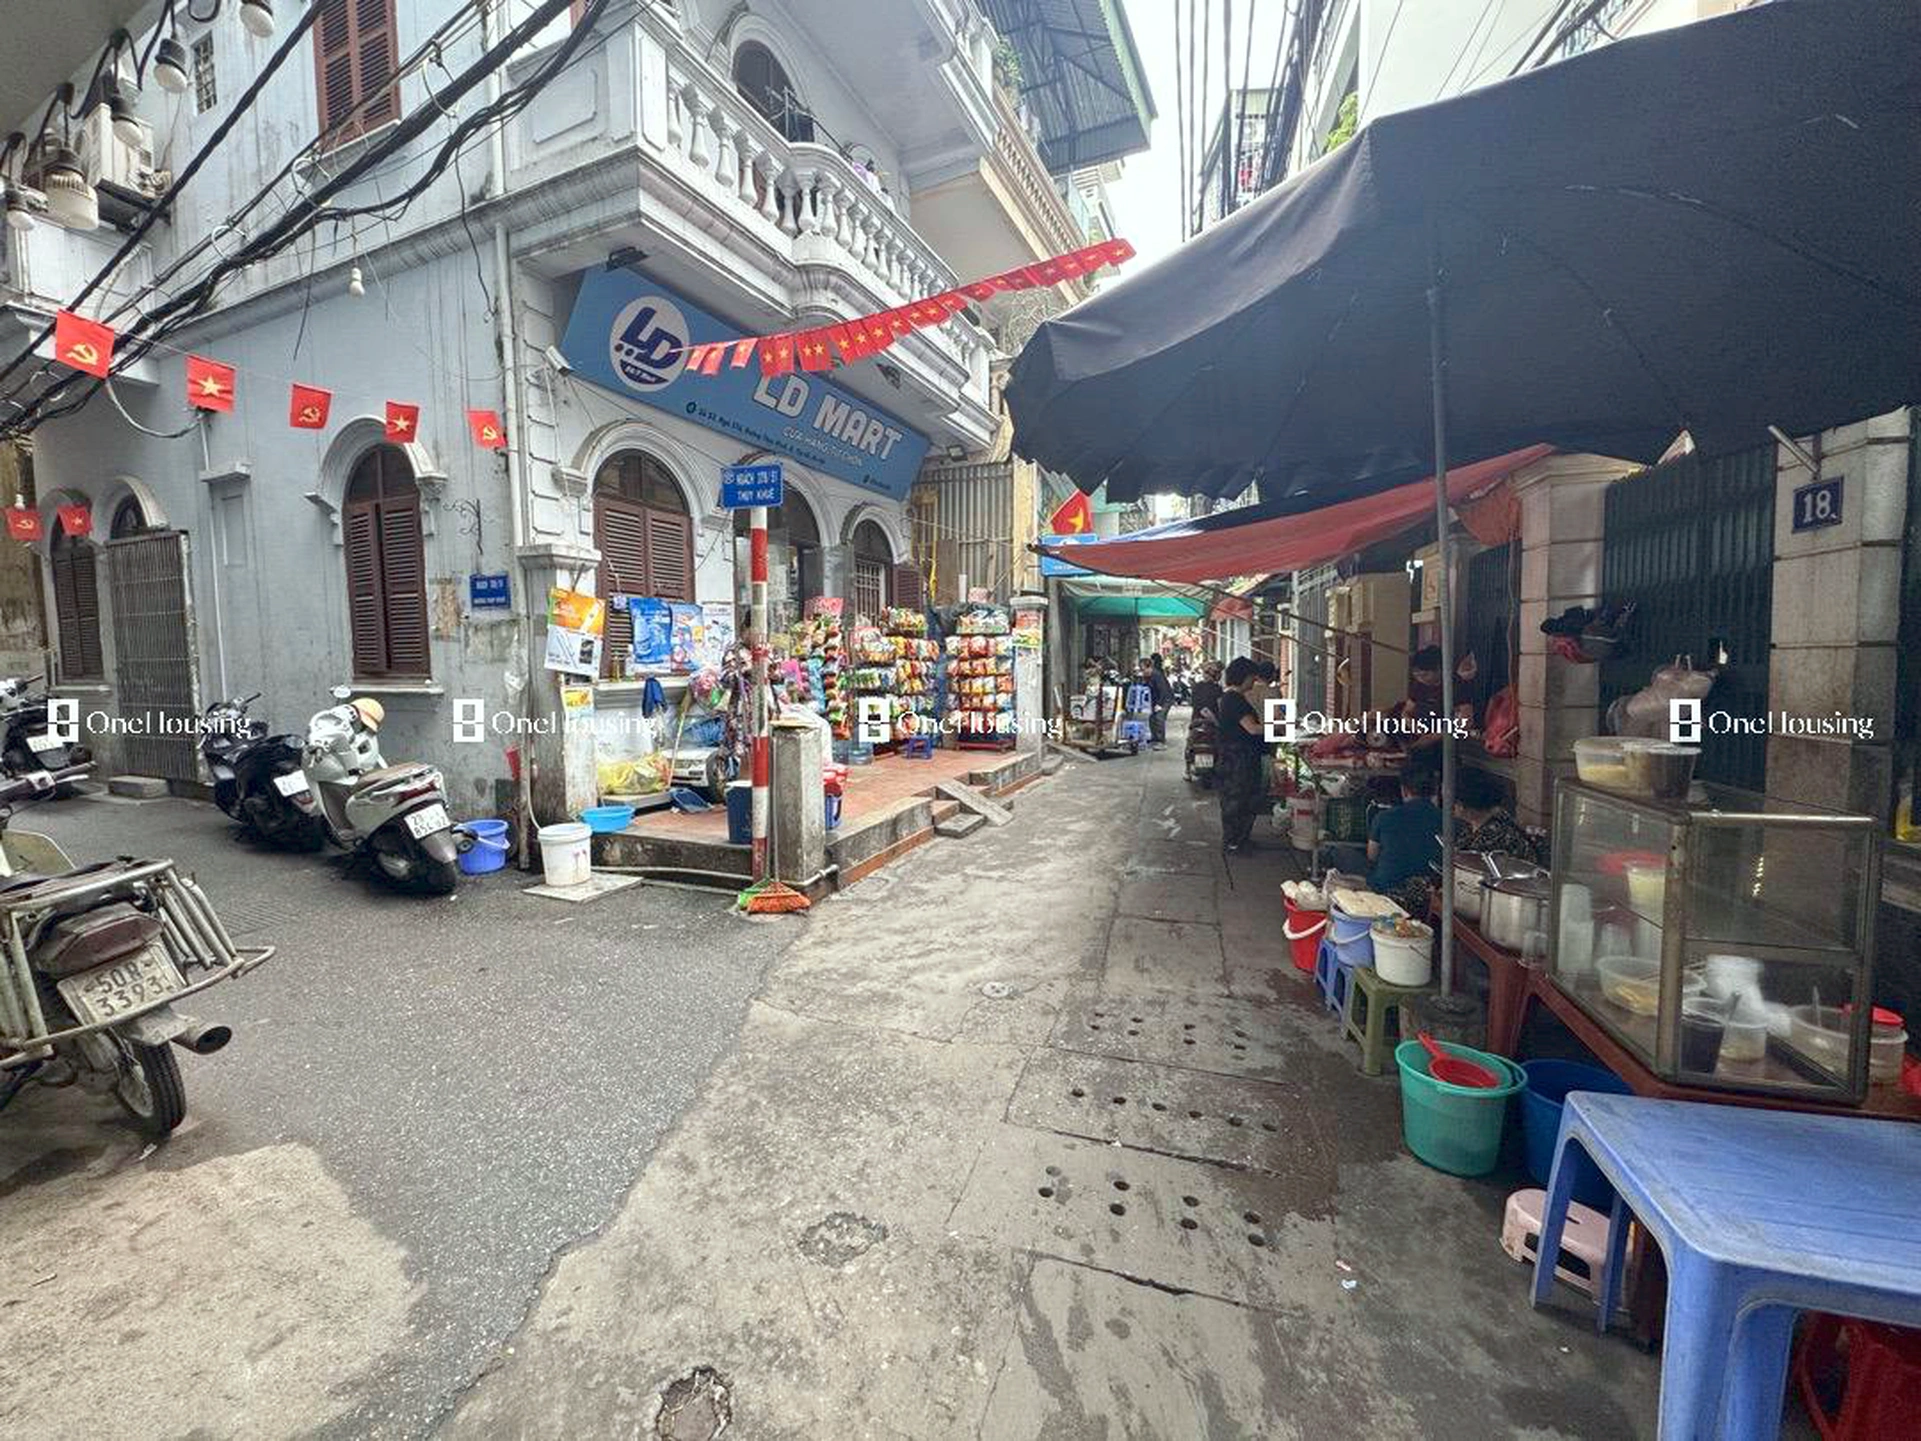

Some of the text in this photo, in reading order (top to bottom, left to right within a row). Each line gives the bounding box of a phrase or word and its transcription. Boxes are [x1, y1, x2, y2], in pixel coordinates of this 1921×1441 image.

[753, 375, 903, 460] LD MART
[1803, 489, 1832, 524] 18
[96, 975, 164, 1017] 3393
